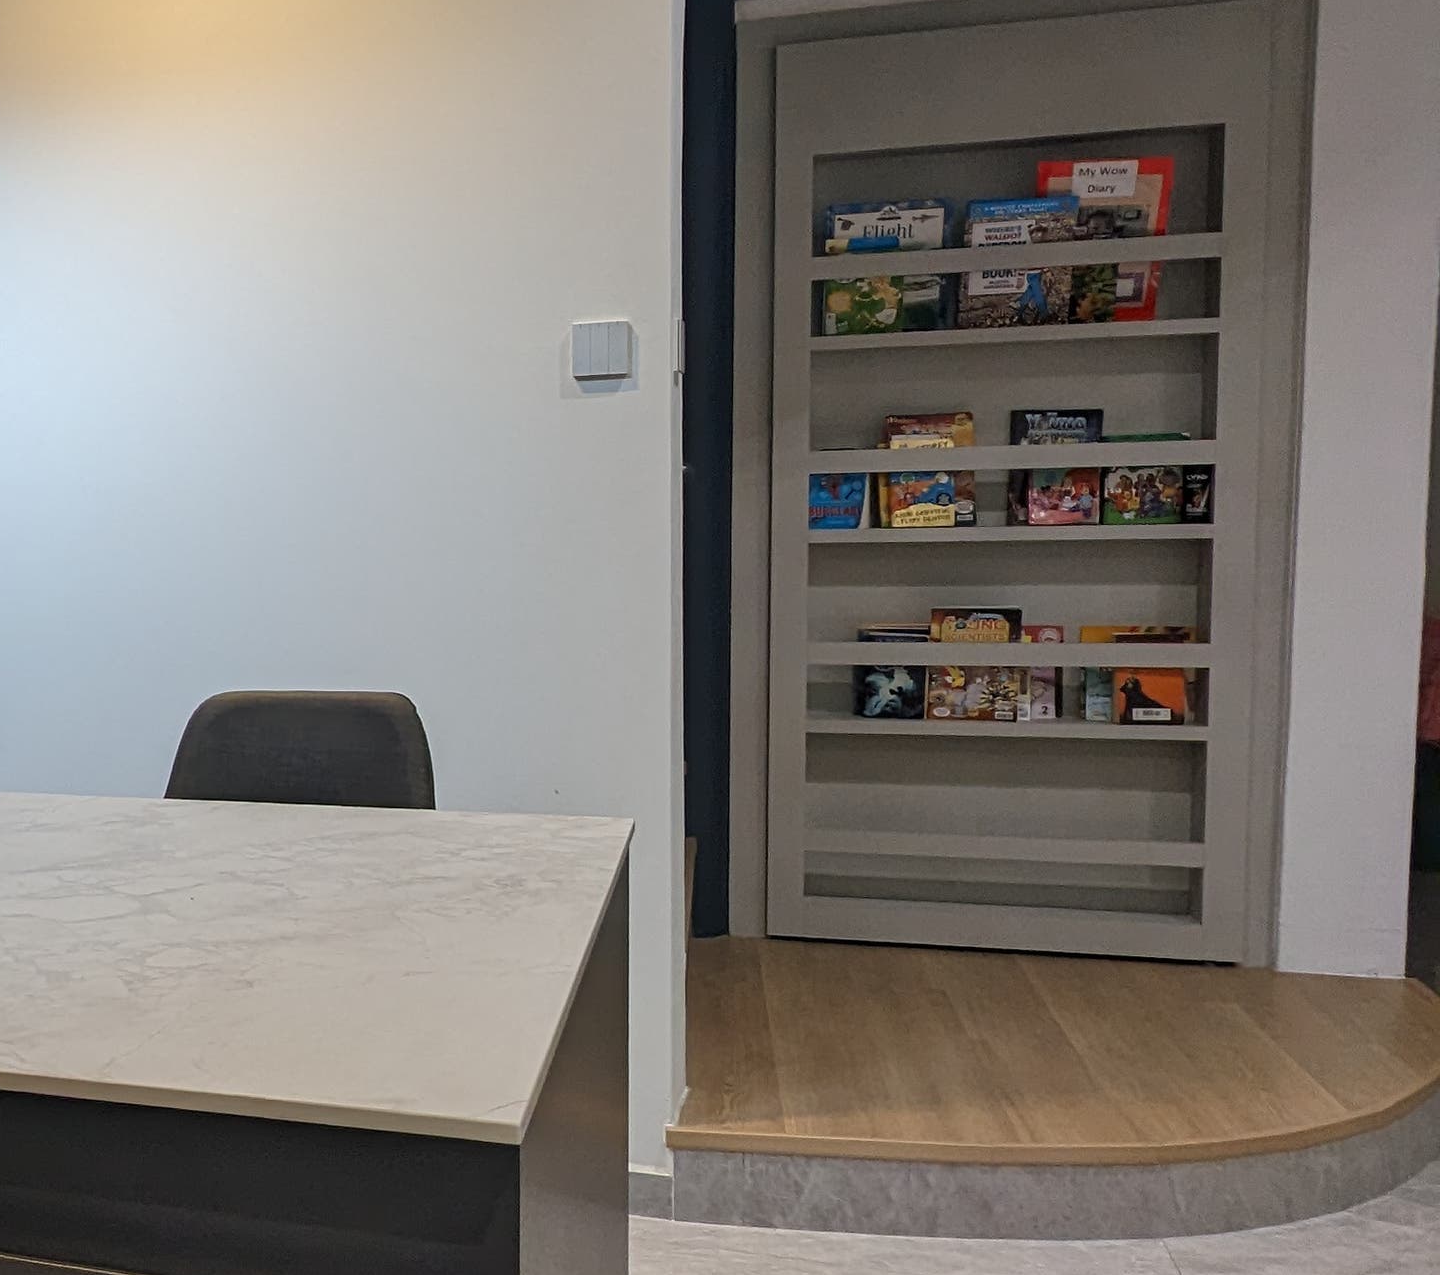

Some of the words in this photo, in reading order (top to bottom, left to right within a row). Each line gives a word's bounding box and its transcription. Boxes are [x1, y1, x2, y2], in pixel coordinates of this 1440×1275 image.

[1079, 167, 1097, 178] My
[1100, 166, 1128, 175] Wow
[1087, 184, 1116, 194] Diary
[1041, 705, 1049, 715] 2
